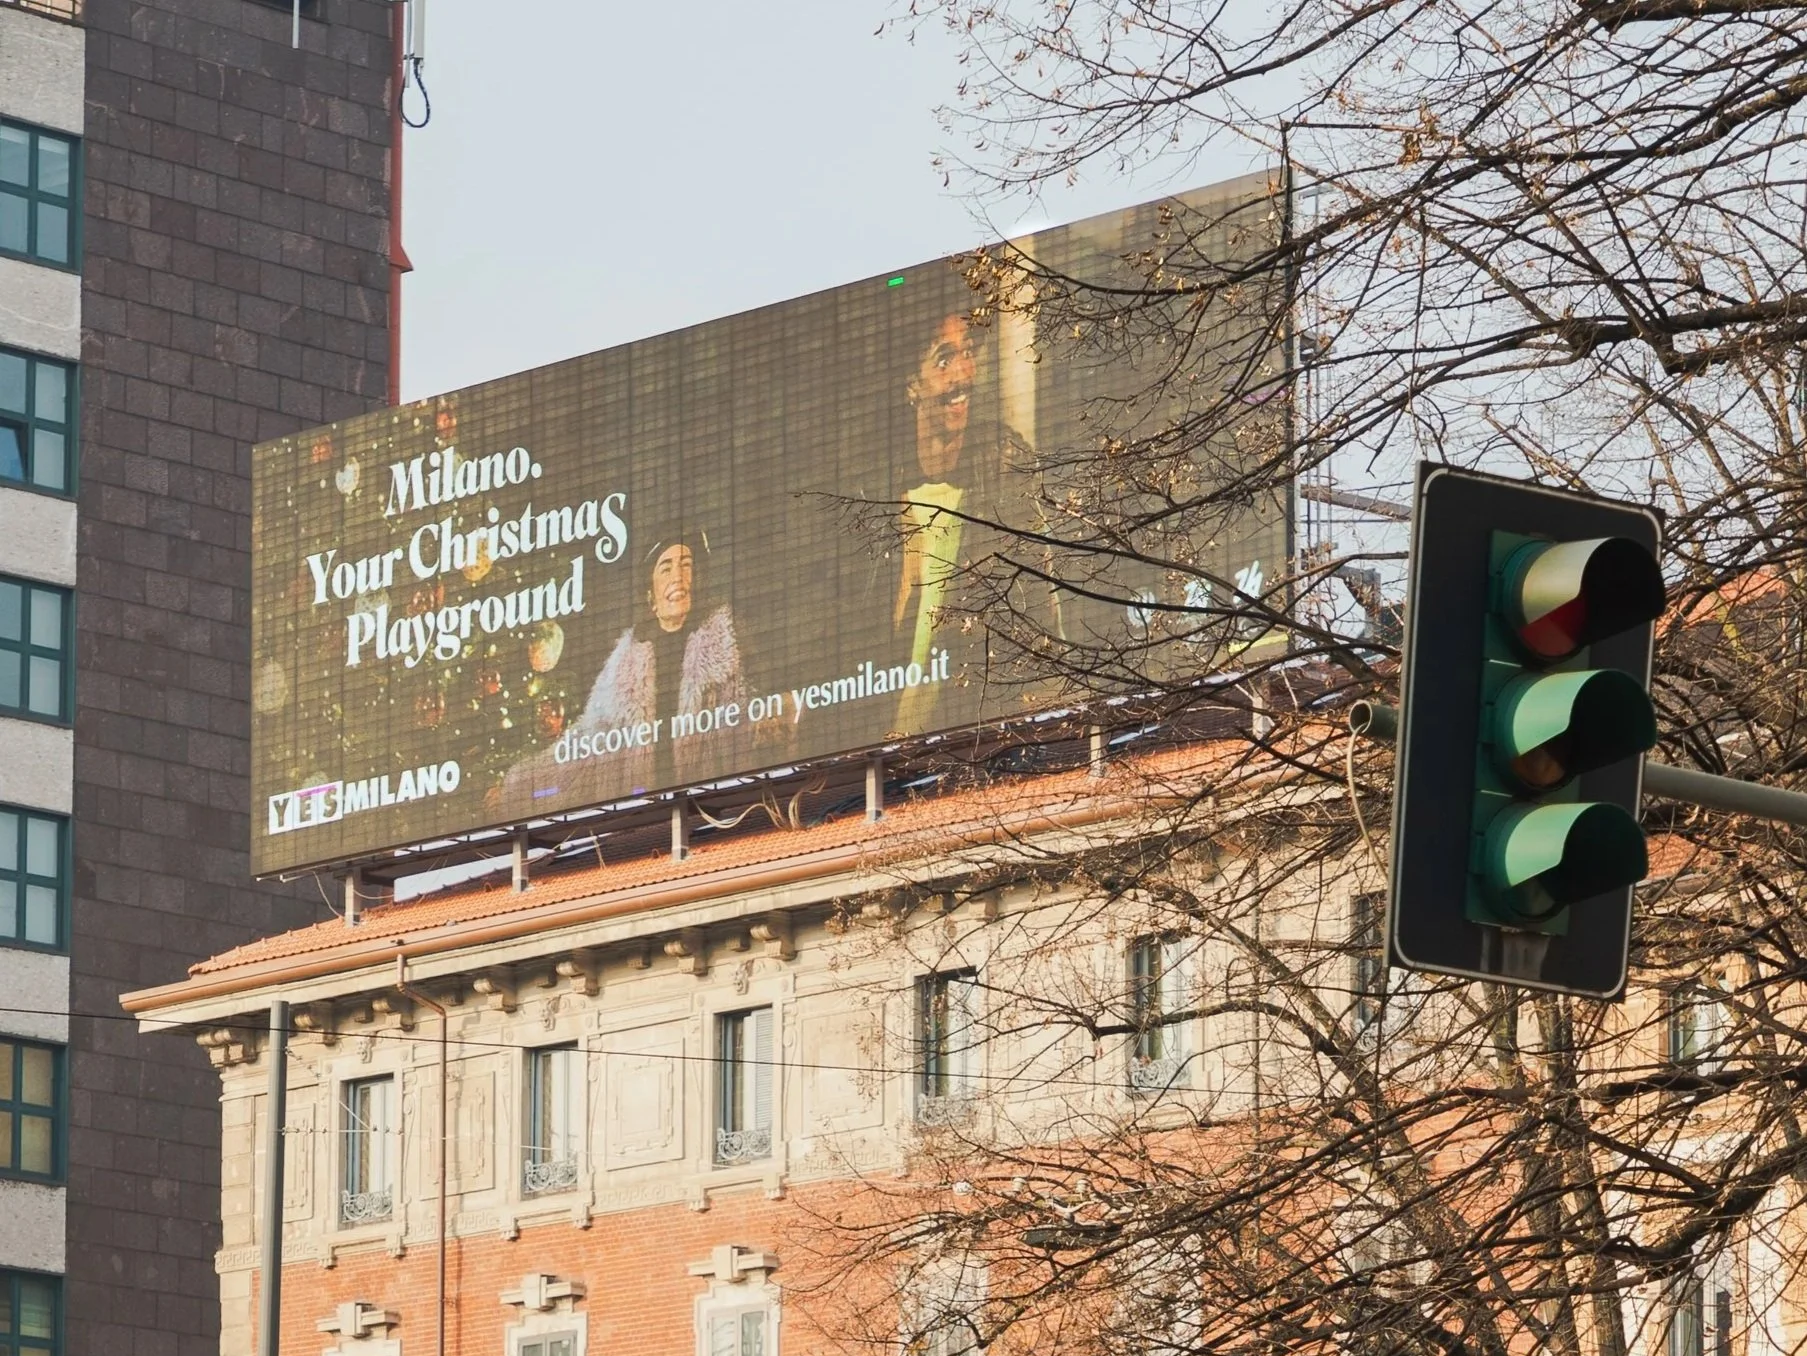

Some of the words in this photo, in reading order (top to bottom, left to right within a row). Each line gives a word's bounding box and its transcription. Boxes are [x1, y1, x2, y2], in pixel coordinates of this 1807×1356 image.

[385, 446, 543, 517] Milano.
[305, 546, 403, 606] Your
[409, 492, 628, 580] Christmas
[345, 556, 586, 668] Playground
[554, 719, 662, 765] discover
[671, 701, 740, 738] more
[748, 692, 783, 722] on
[792, 647, 951, 723] yesmilano.it
